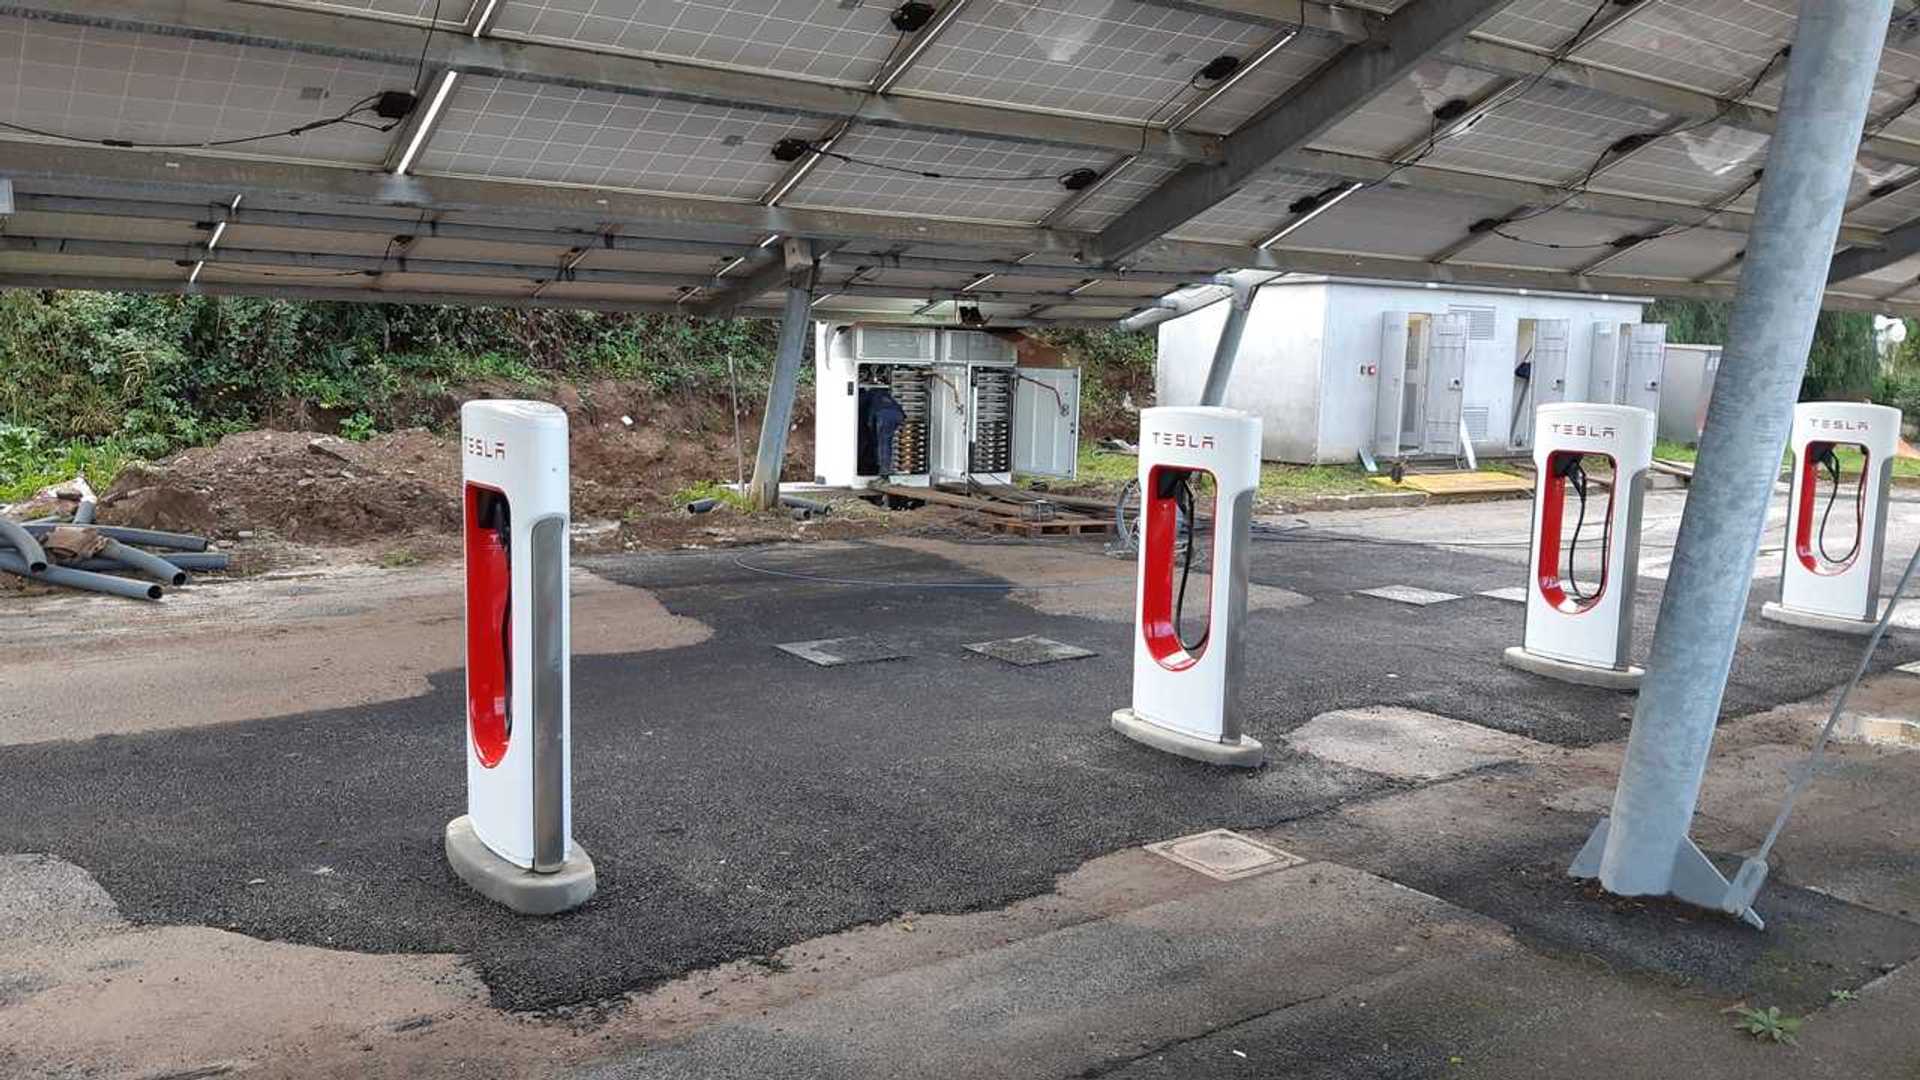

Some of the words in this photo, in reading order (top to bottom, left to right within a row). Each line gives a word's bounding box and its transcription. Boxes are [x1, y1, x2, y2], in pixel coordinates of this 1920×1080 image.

[1552, 424, 1614, 438] TESLA
[1810, 418, 1868, 430] TESLA
[1152, 432, 1214, 449] TESLA
